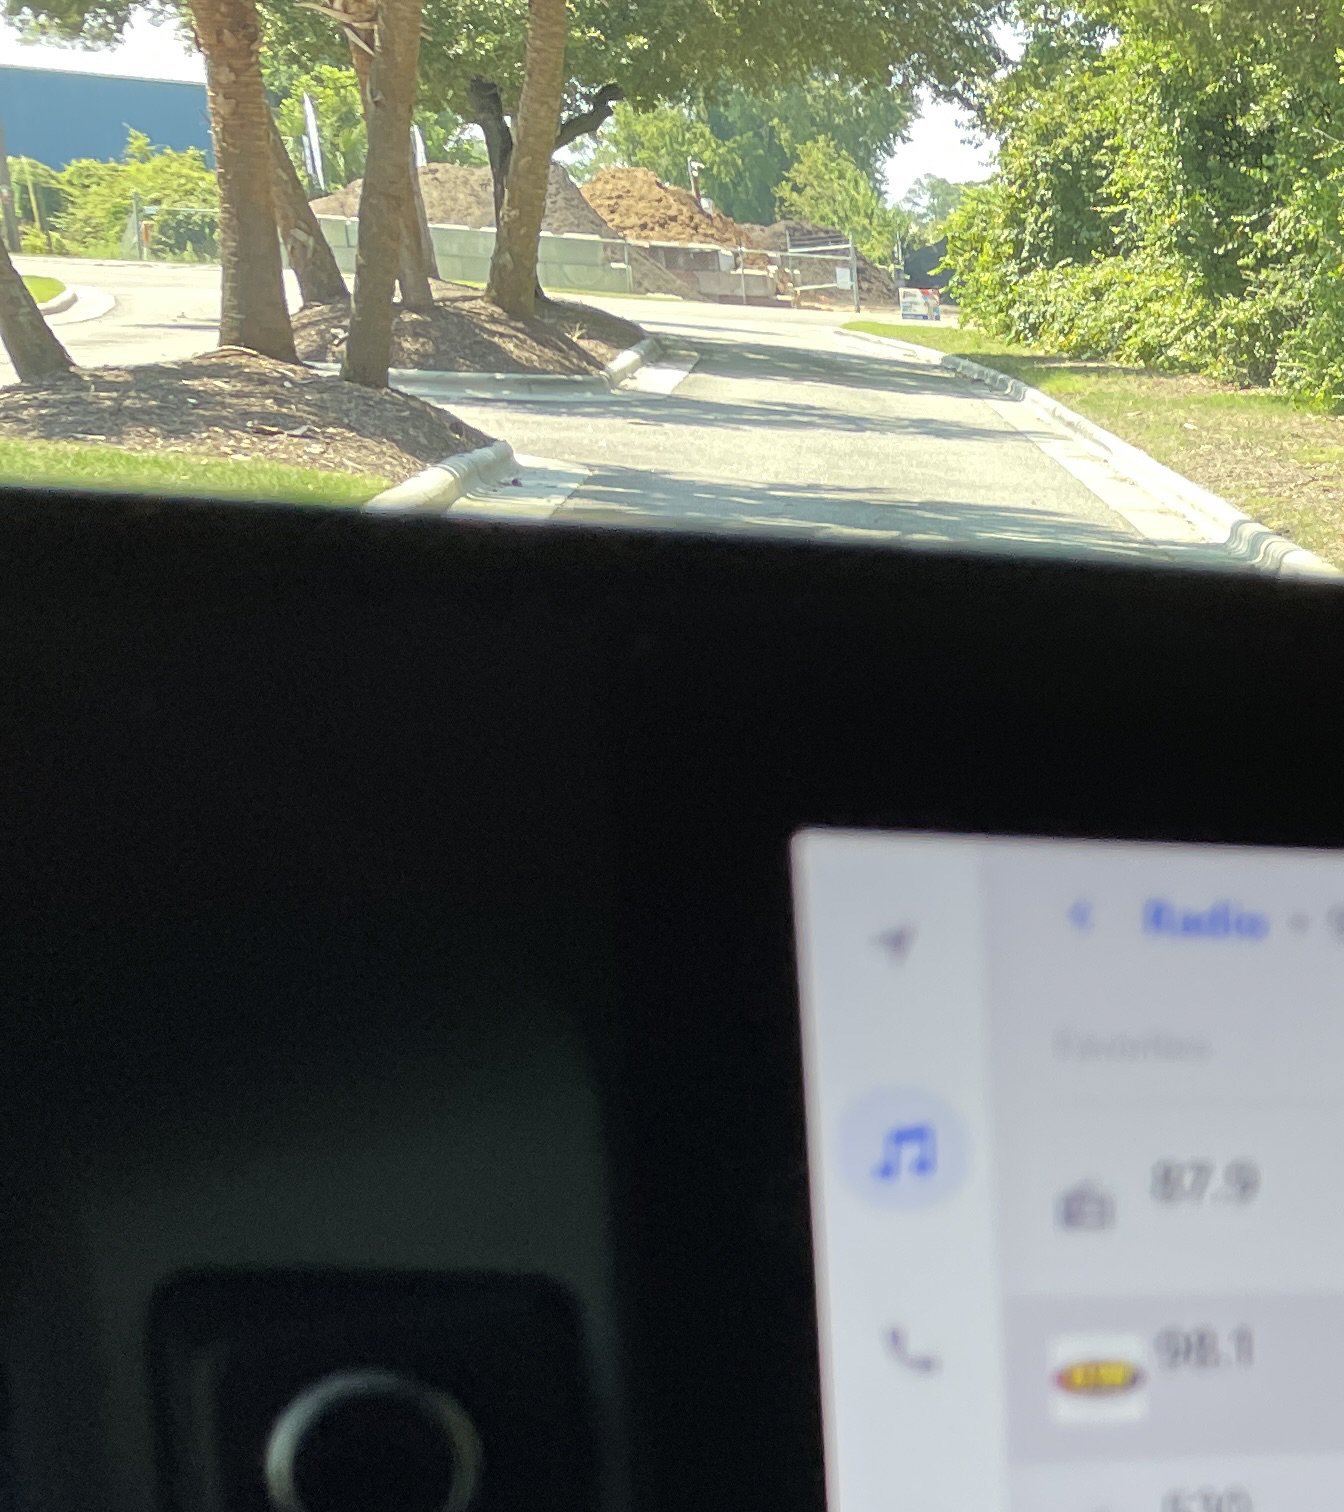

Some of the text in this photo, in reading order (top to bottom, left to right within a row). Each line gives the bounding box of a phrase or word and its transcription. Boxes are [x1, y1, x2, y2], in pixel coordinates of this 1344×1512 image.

[1142, 897, 1271, 940] Radio
[1150, 1156, 1262, 1206] 87.9
[1154, 1325, 1255, 1377] 98.1
